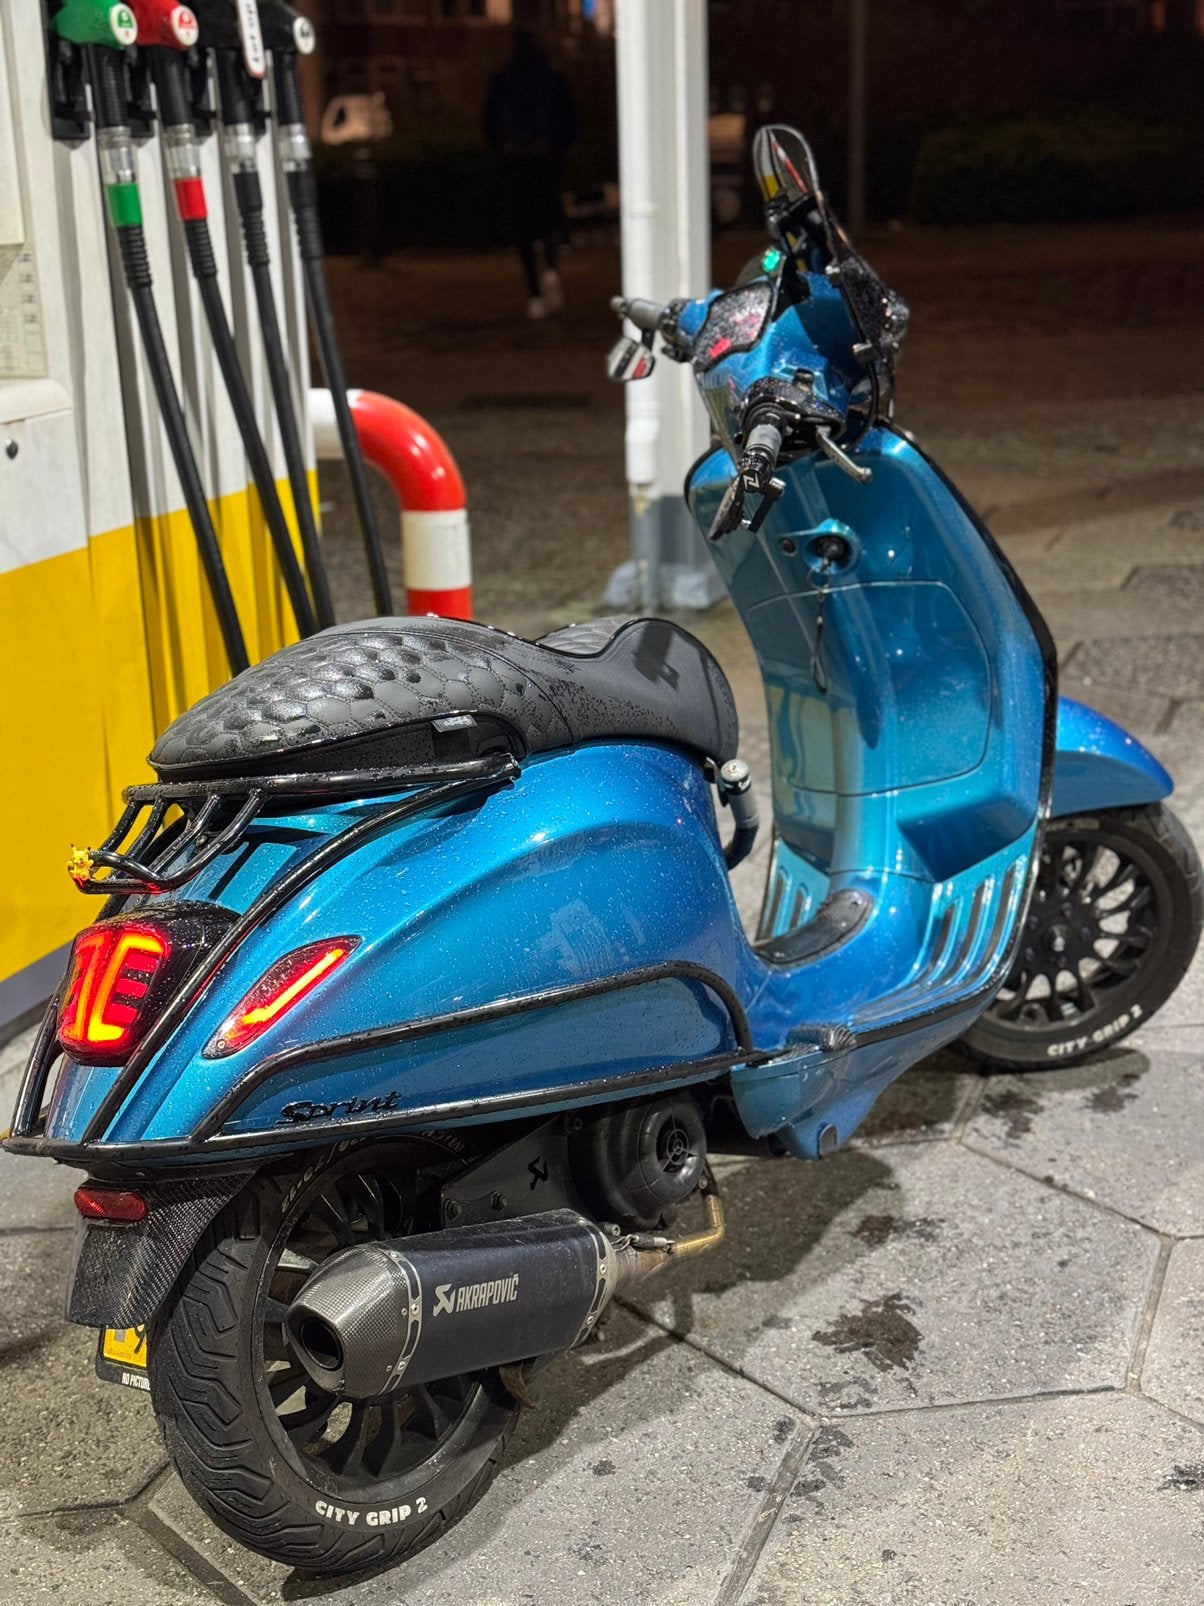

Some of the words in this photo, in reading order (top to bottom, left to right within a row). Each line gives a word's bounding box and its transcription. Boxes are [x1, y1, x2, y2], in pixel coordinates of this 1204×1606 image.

[1046, 1035, 1088, 1056] CITY
[278, 1091, 401, 1125] Sprint
[315, 1500, 360, 1525] CITY
[366, 1505, 412, 1526] GRIP
[415, 1497, 428, 1513] 2
